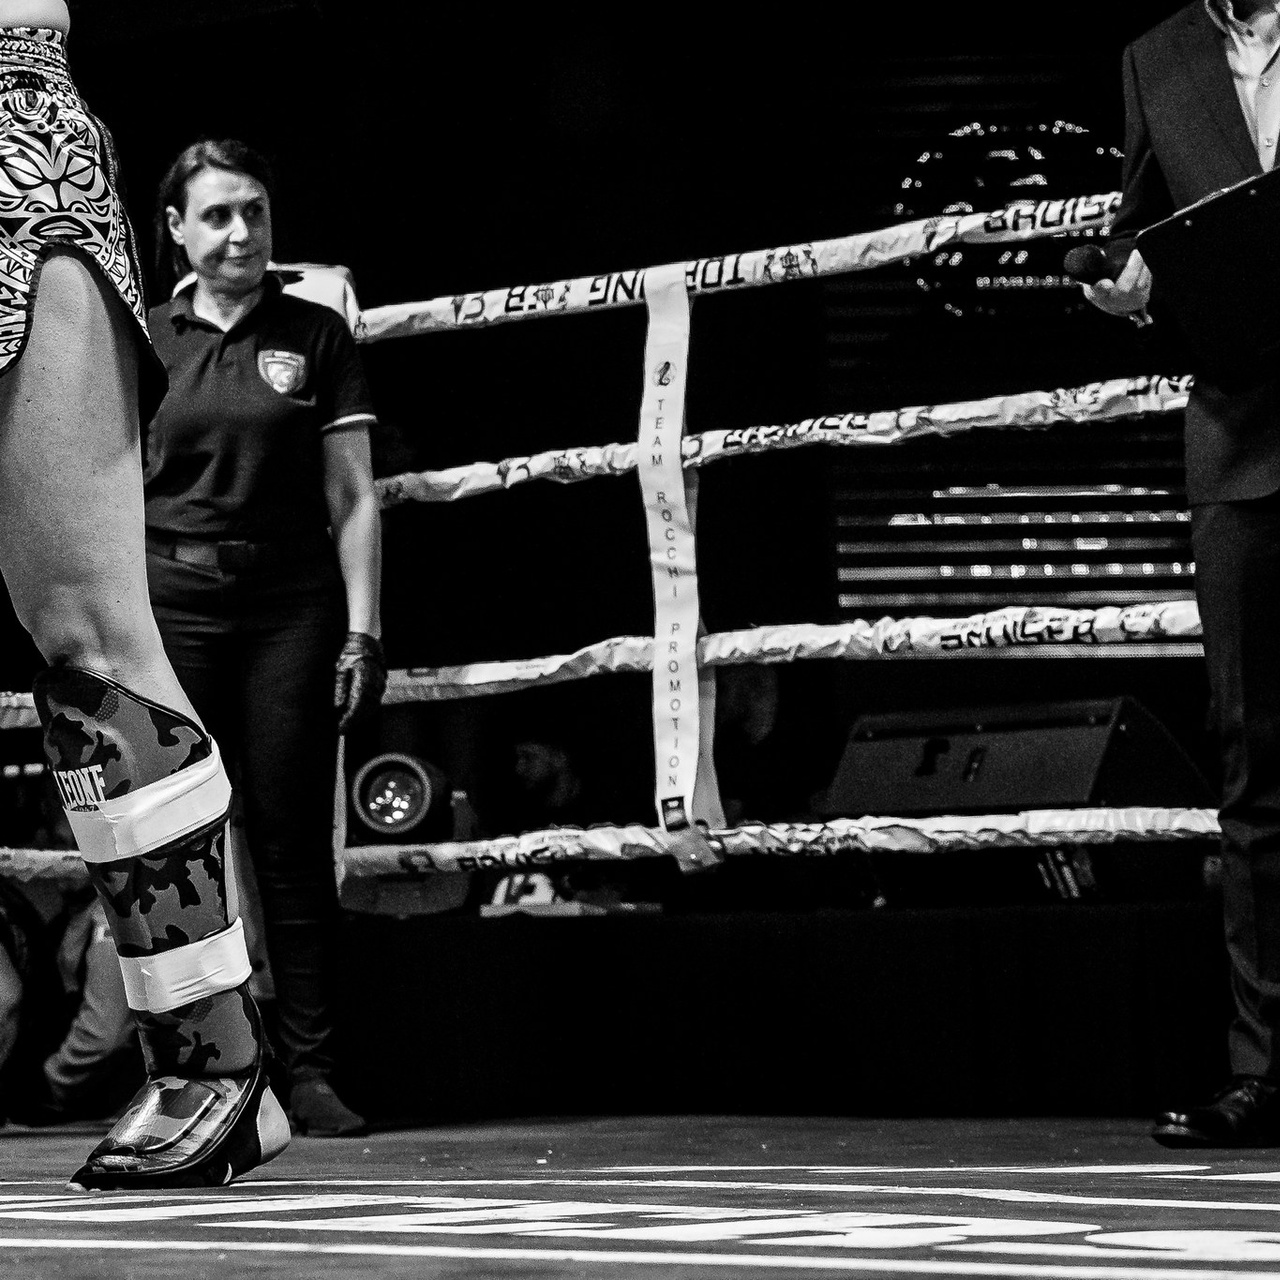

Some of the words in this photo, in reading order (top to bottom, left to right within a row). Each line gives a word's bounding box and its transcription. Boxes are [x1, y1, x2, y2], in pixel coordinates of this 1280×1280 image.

[651, 398, 665, 467] TEAM
[657, 491, 680, 598] ROCCHI
[668, 622, 682, 786] PROMOTION
